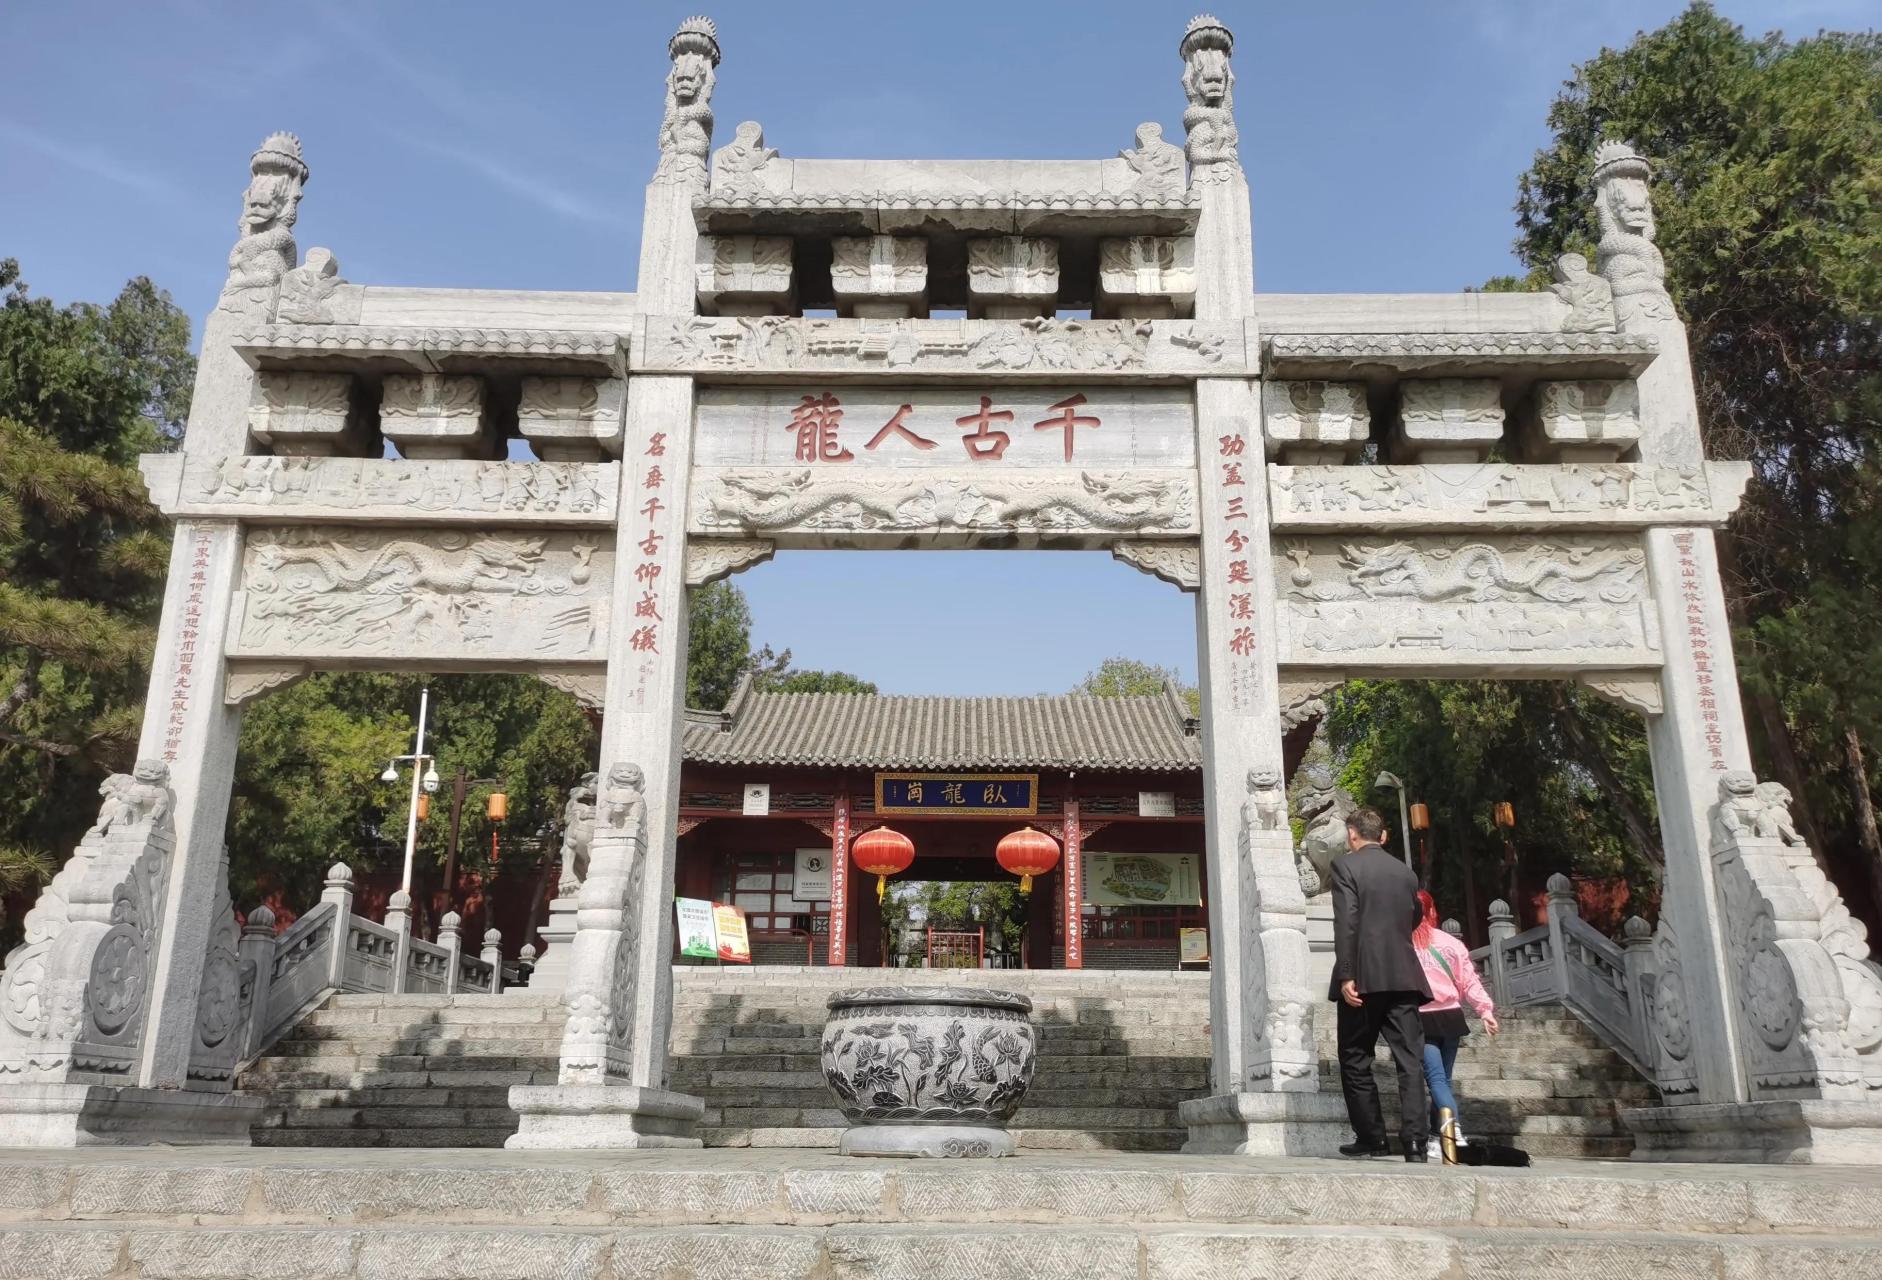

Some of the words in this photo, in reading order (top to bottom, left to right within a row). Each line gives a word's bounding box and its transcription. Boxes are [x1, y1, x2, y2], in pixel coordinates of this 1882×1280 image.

[784, 391, 1102, 463] 千古人龍
[629, 431, 667, 655] 名垂千古仰威儀
